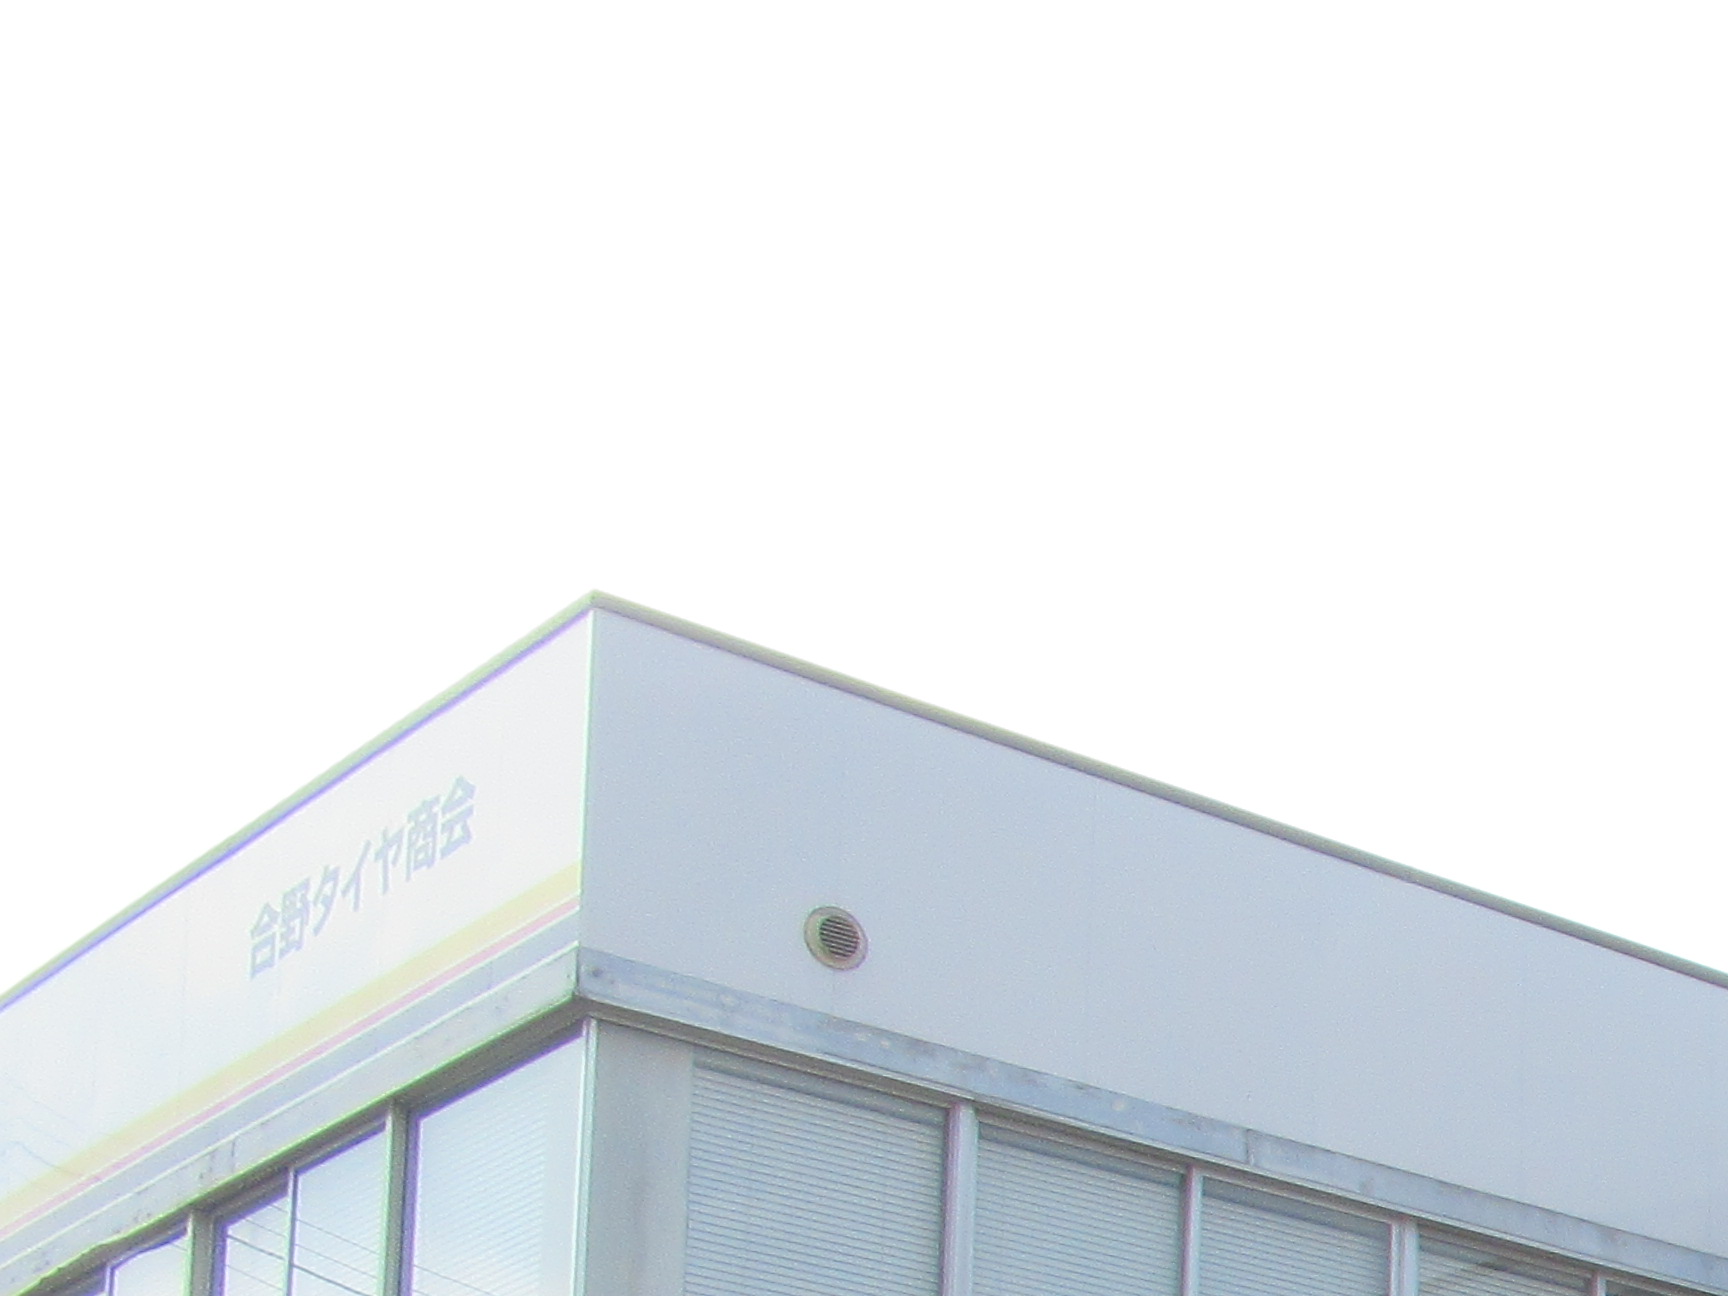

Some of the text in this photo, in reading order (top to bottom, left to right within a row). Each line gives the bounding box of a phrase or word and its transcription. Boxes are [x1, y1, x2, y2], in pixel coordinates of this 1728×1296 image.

[249, 775, 476, 979] 合野タイヤ商会
